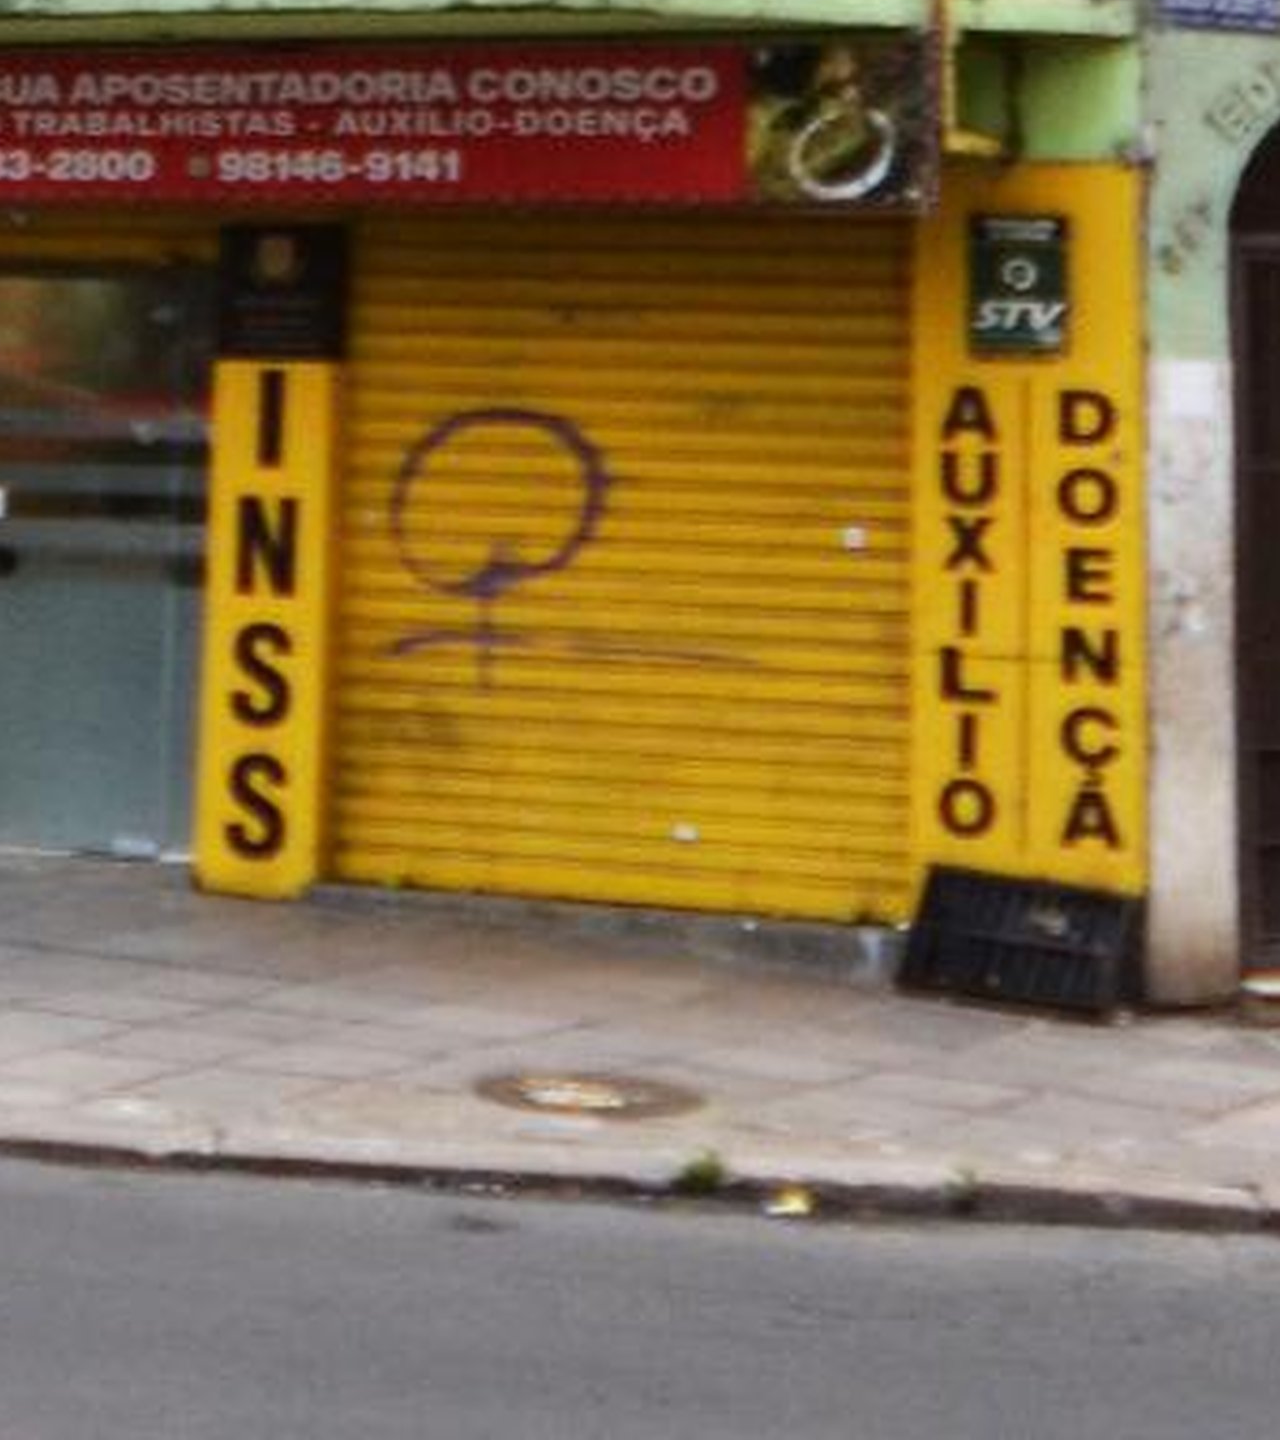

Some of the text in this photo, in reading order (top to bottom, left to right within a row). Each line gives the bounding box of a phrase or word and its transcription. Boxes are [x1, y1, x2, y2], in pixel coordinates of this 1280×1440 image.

[16, 110, 296, 137] TRABALHISTAS
[69, 70, 458, 105] APOSENTADORIA
[468, 67, 718, 102] CONOSCO
[971, 300, 1067, 329] STV
[225, 368, 301, 860] INSS
[939, 386, 999, 838] AUXILIO
[1057, 388, 1120, 848] DOENÇA
